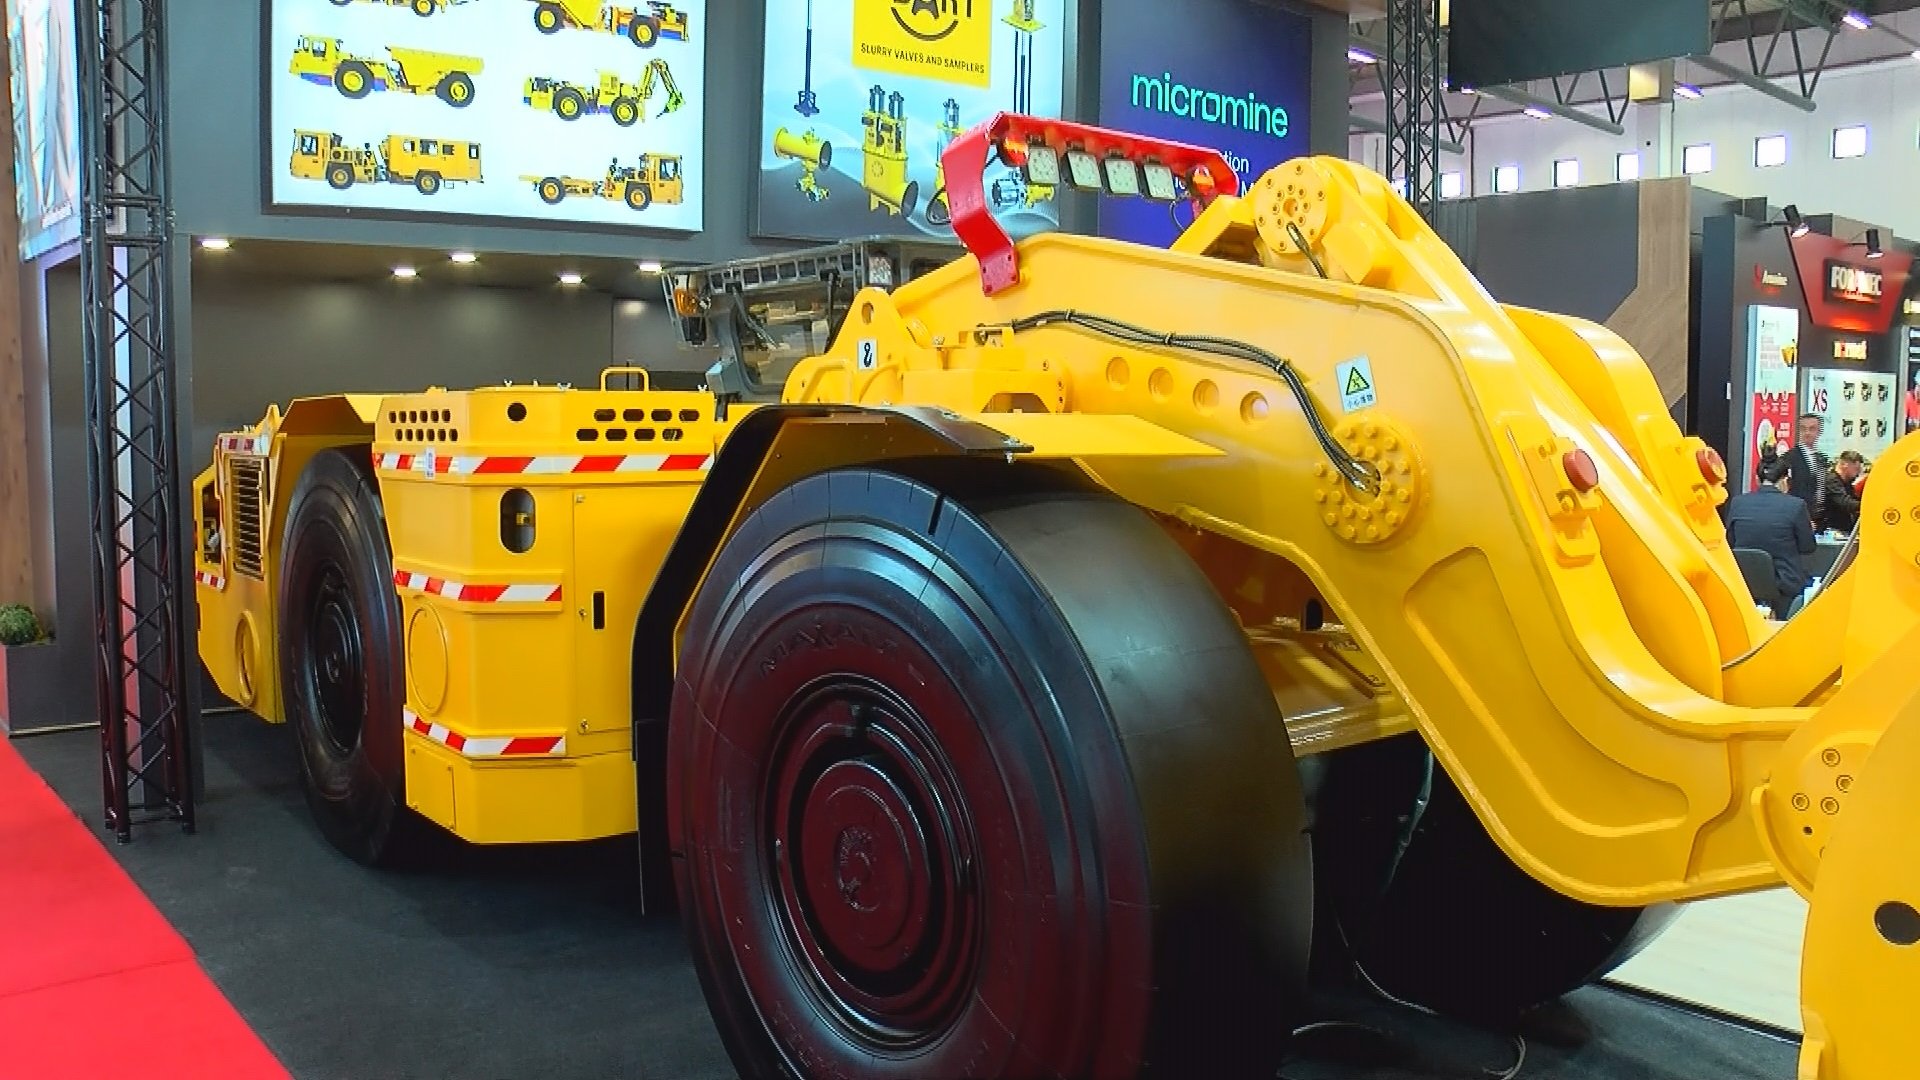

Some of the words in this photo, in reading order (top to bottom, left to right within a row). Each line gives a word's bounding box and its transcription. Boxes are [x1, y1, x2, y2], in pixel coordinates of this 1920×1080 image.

[861, 42, 892, 57] SLURRY
[894, 49, 924, 63] VALVES
[925, 54, 943, 66] AND
[944, 58, 985, 74] SAMPLERS
[1132, 72, 1289, 137] micromine
[1812, 388, 1828, 413] XS
